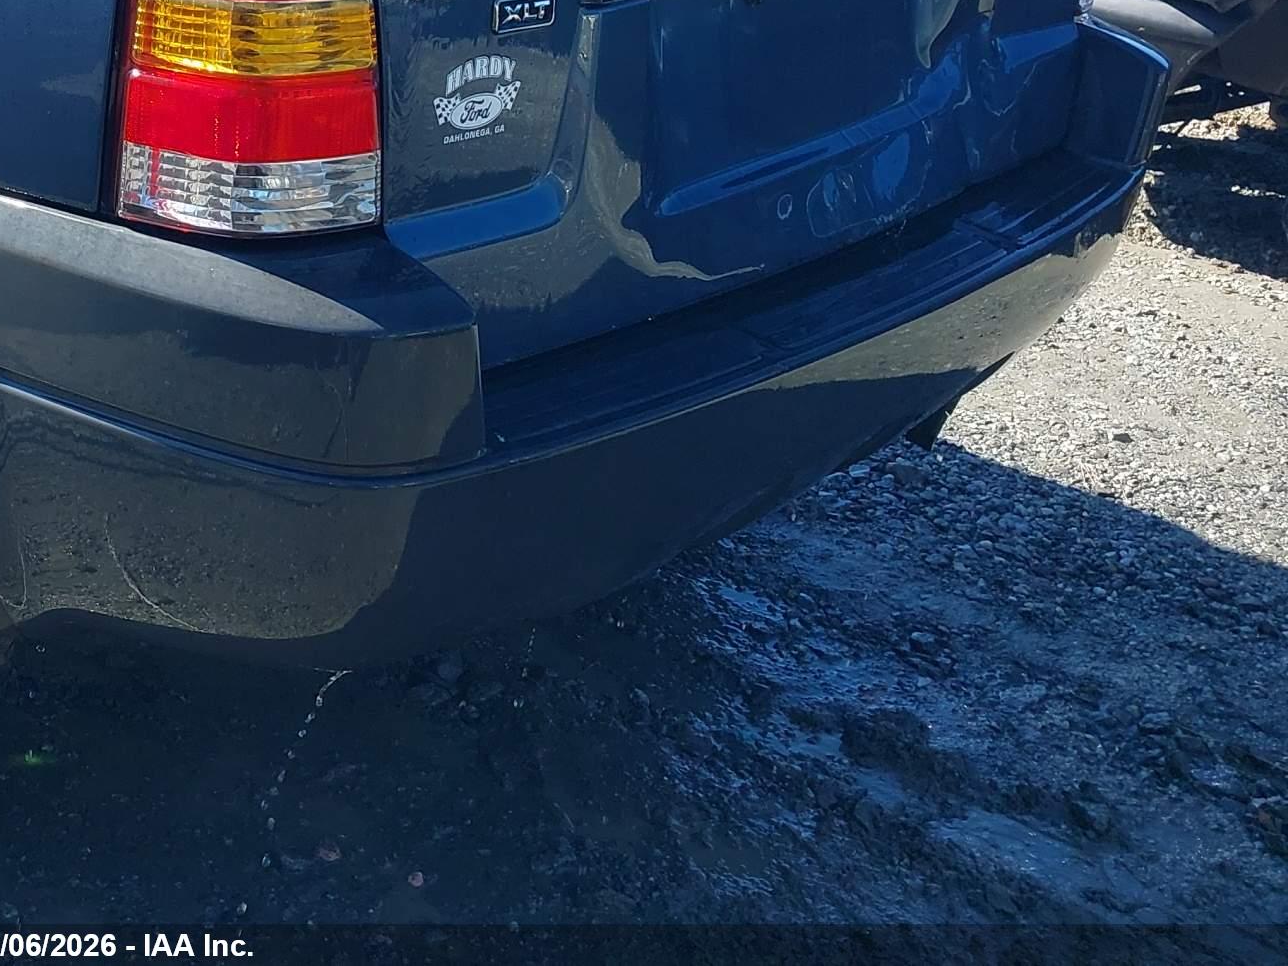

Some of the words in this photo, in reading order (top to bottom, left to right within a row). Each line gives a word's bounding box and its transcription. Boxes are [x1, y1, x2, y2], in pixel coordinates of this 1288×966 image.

[502, 0, 551, 25] XLT
[446, 55, 517, 97] HARDY
[459, 98, 494, 124] Ford
[494, 124, 506, 134] GA
